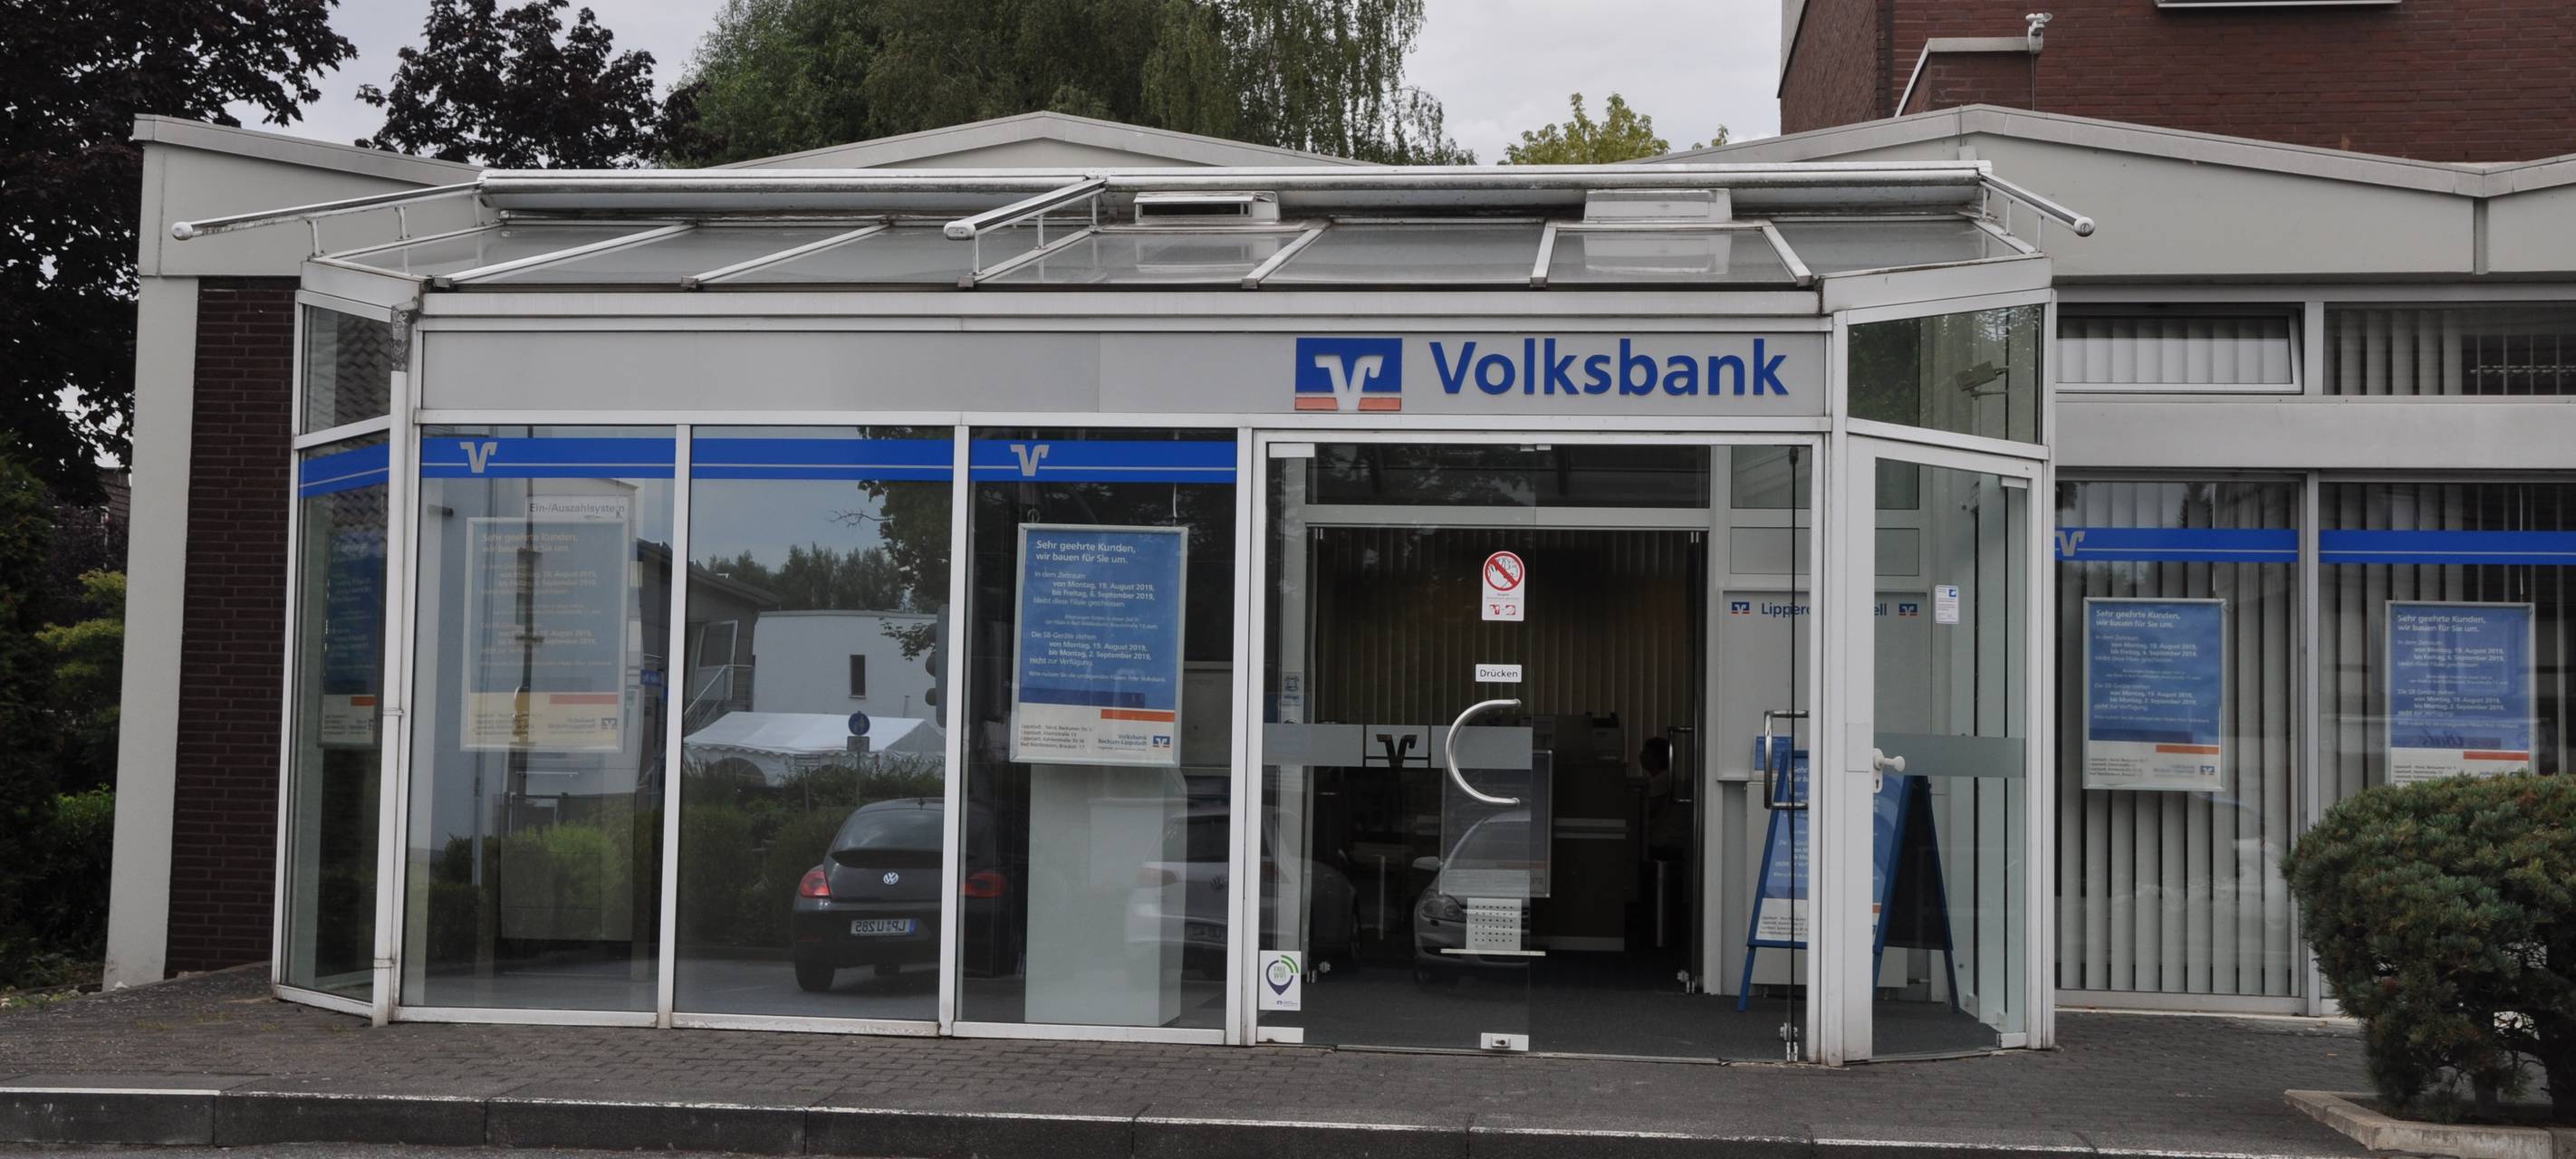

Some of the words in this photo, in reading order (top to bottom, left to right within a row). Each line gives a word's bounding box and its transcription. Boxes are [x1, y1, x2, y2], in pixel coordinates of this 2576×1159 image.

[1429, 338, 1789, 396] Volksbank
[1036, 541, 1057, 549] Sehr
[1060, 541, 1095, 551] geehrte
[1098, 543, 1136, 553] Kunden,
[1053, 552, 1079, 561] bauen
[1097, 554, 1109, 562] Sie
[1069, 580, 1096, 589] Montag,
[1098, 592, 1134, 600] September
[1875, 603, 1887, 616] ell
[1104, 643, 1128, 651] August
[1480, 669, 1518, 677] Drücken
